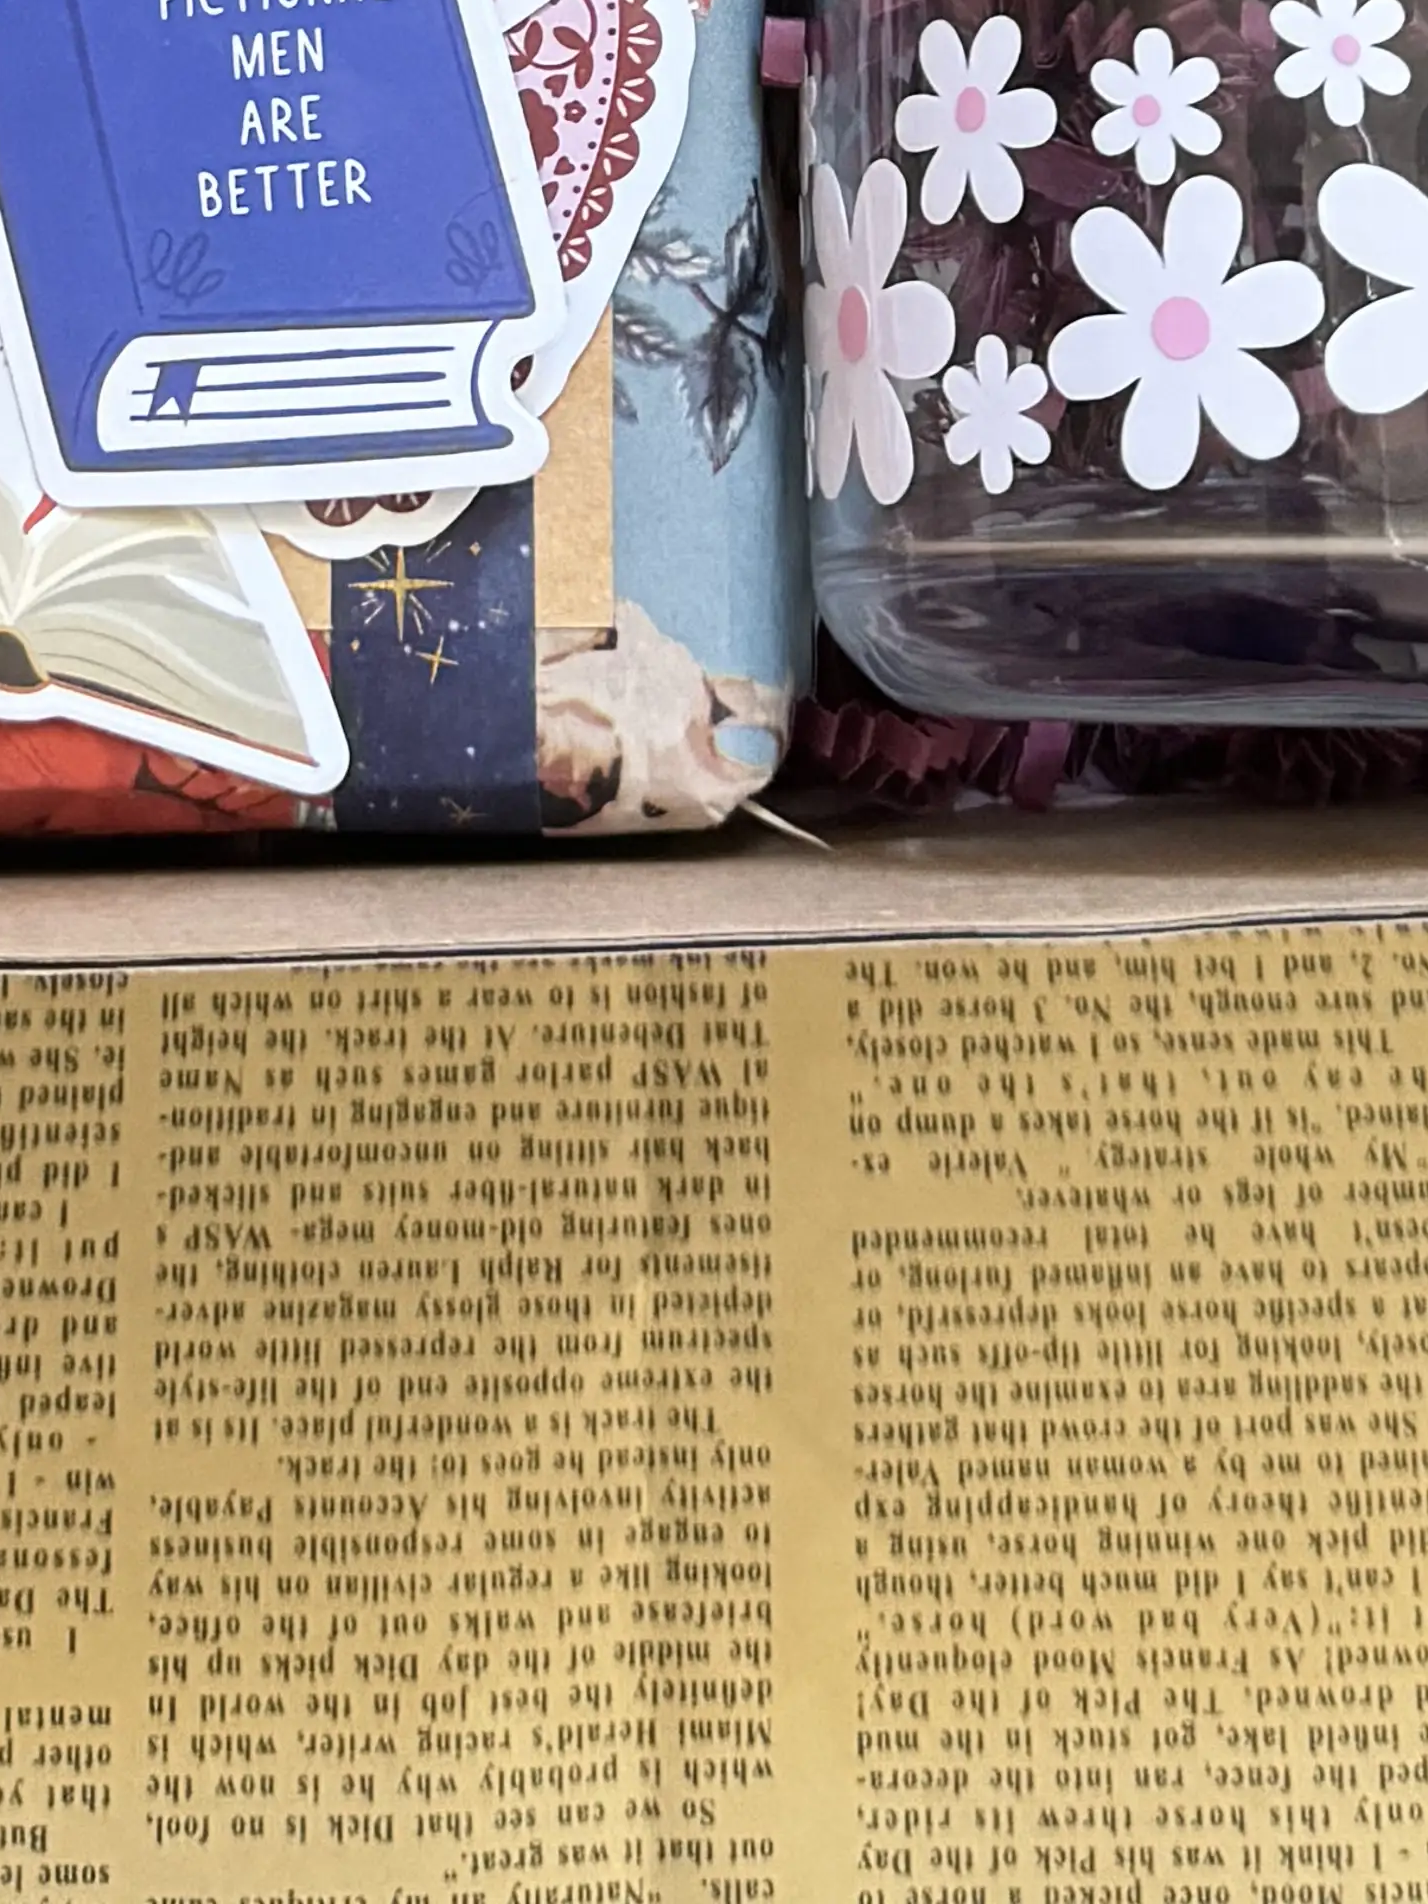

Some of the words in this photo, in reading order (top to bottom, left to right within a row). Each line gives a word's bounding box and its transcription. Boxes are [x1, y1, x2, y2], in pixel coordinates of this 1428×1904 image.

[231, 28, 324, 79] MEN
[240, 94, 322, 147] ARE
[196, 159, 373, 220] BETTER
[66, 1625, 78, 1656] I
